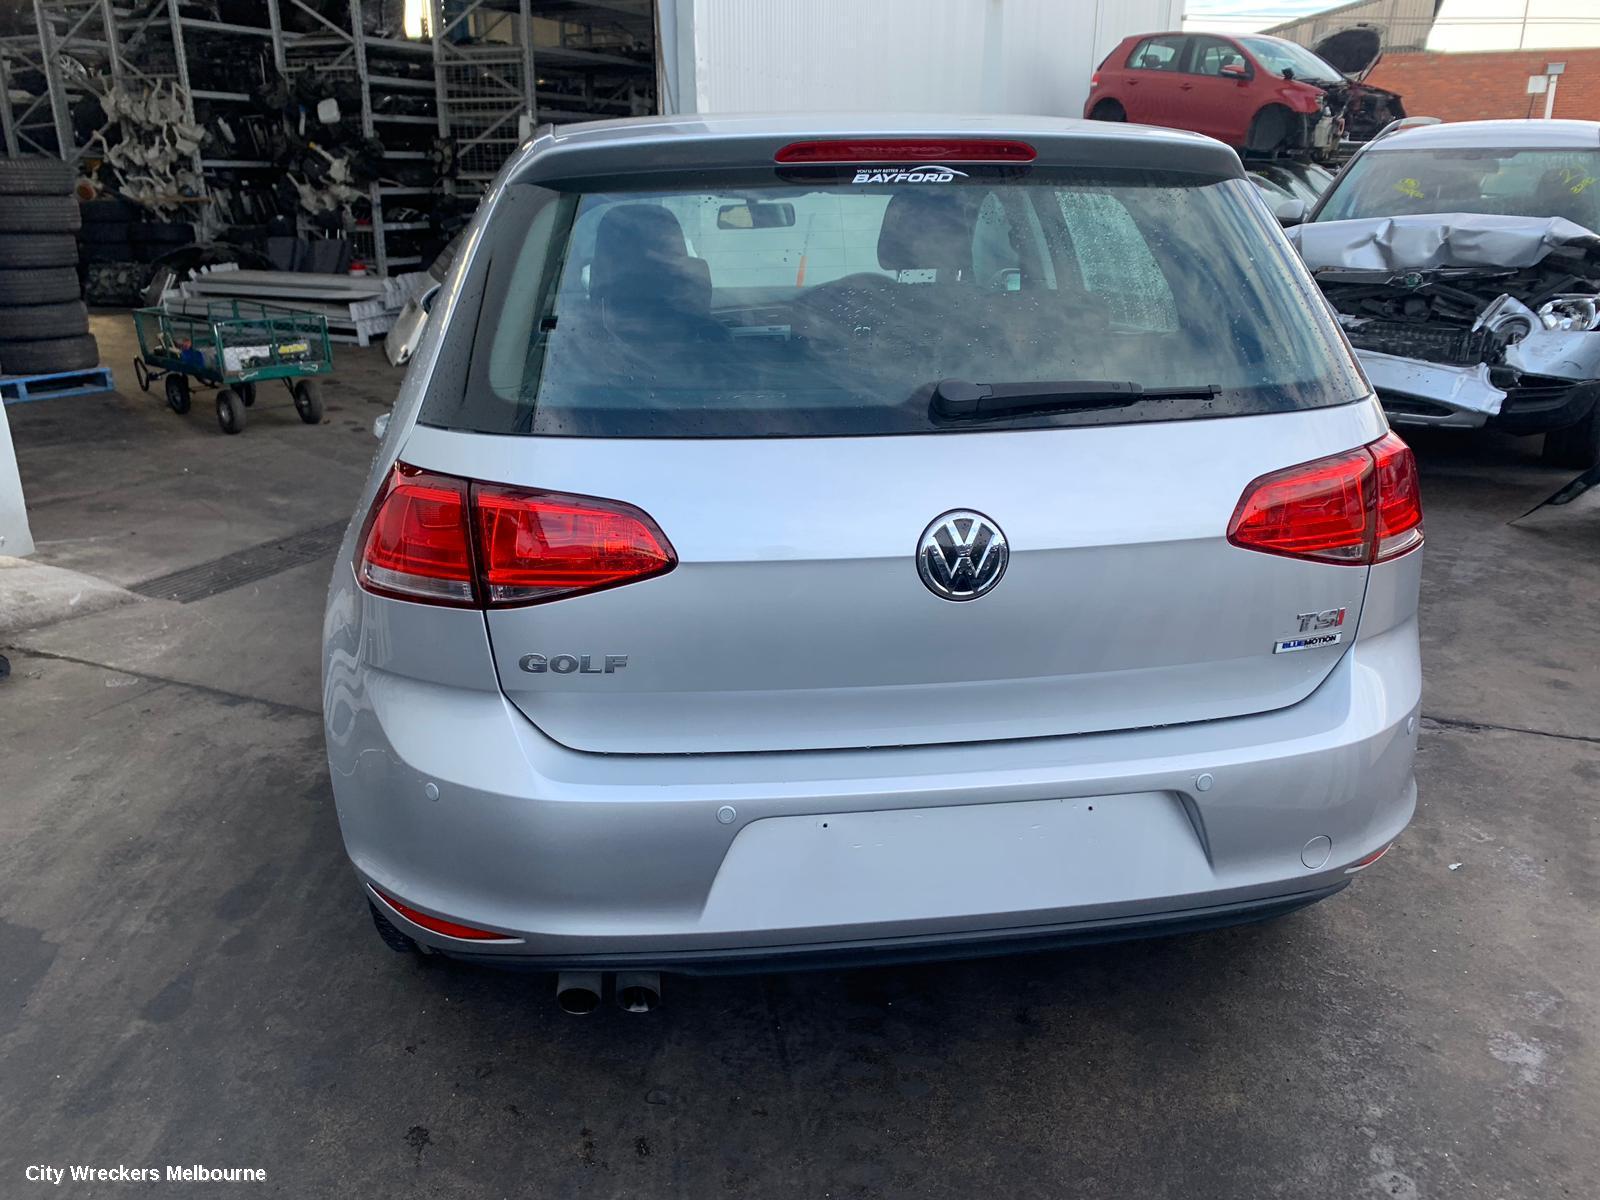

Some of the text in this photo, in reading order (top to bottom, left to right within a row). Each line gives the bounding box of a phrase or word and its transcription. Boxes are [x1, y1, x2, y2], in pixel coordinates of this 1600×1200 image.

[852, 173, 954, 183] BAYFORD
[1282, 635, 1337, 649] BLUEMOTION
[518, 652, 628, 674] GOLF
